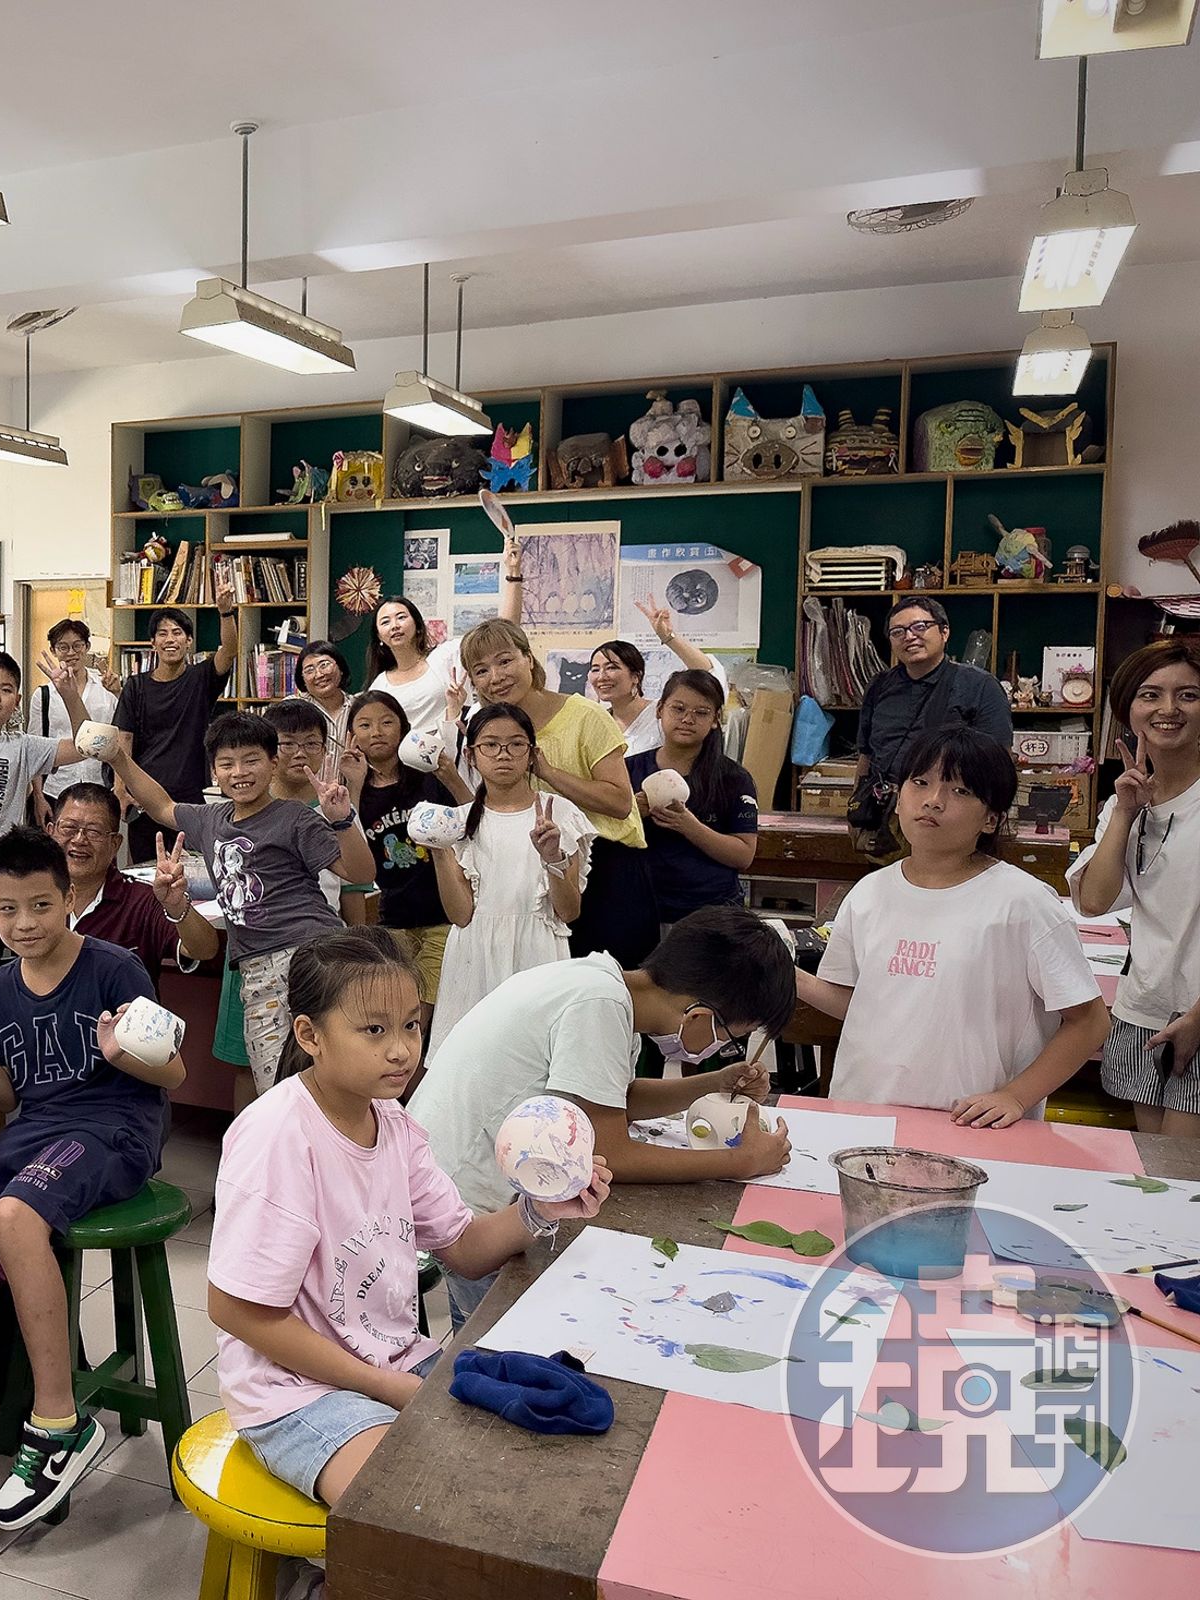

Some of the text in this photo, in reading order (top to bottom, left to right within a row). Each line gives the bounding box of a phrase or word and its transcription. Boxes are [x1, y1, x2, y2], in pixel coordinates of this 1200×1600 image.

[1024, 741, 1047, 753] 杯子
[895, 938, 938, 961] RADI
[887, 955, 937, 978] ANCE
[0, 1012, 105, 1091] GAP
